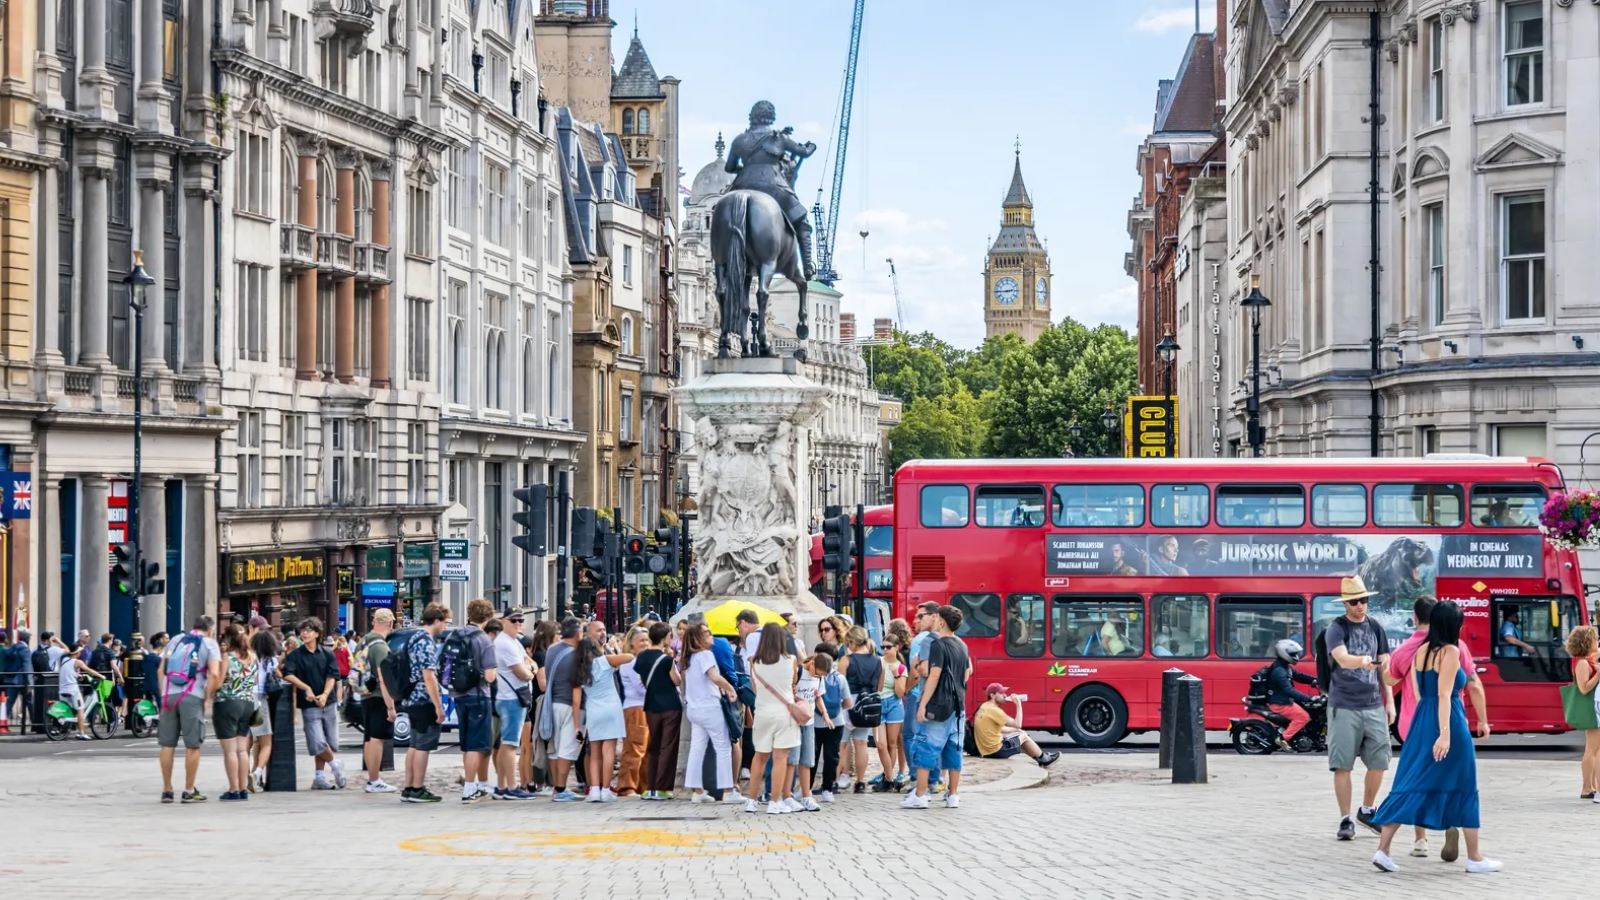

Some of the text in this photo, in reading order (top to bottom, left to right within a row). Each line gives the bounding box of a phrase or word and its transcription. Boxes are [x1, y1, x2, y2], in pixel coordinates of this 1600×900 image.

[1211, 263, 1221, 396] Trafalgar
[1139, 406, 1166, 457] CLUE
[1053, 541, 1104, 549] SCARLETT JOHANSSON
[1470, 542, 1509, 552] IN CINEMAS
[1057, 551, 1099, 559] MAHERSHALA ALI
[1219, 541, 1358, 563] JURASSIC WORLD
[1057, 561, 1099, 569] JONATHAN BAILEY
[1447, 555, 1533, 568] WEDNESDAY JULY 2
[1440, 596, 1490, 607] troline
